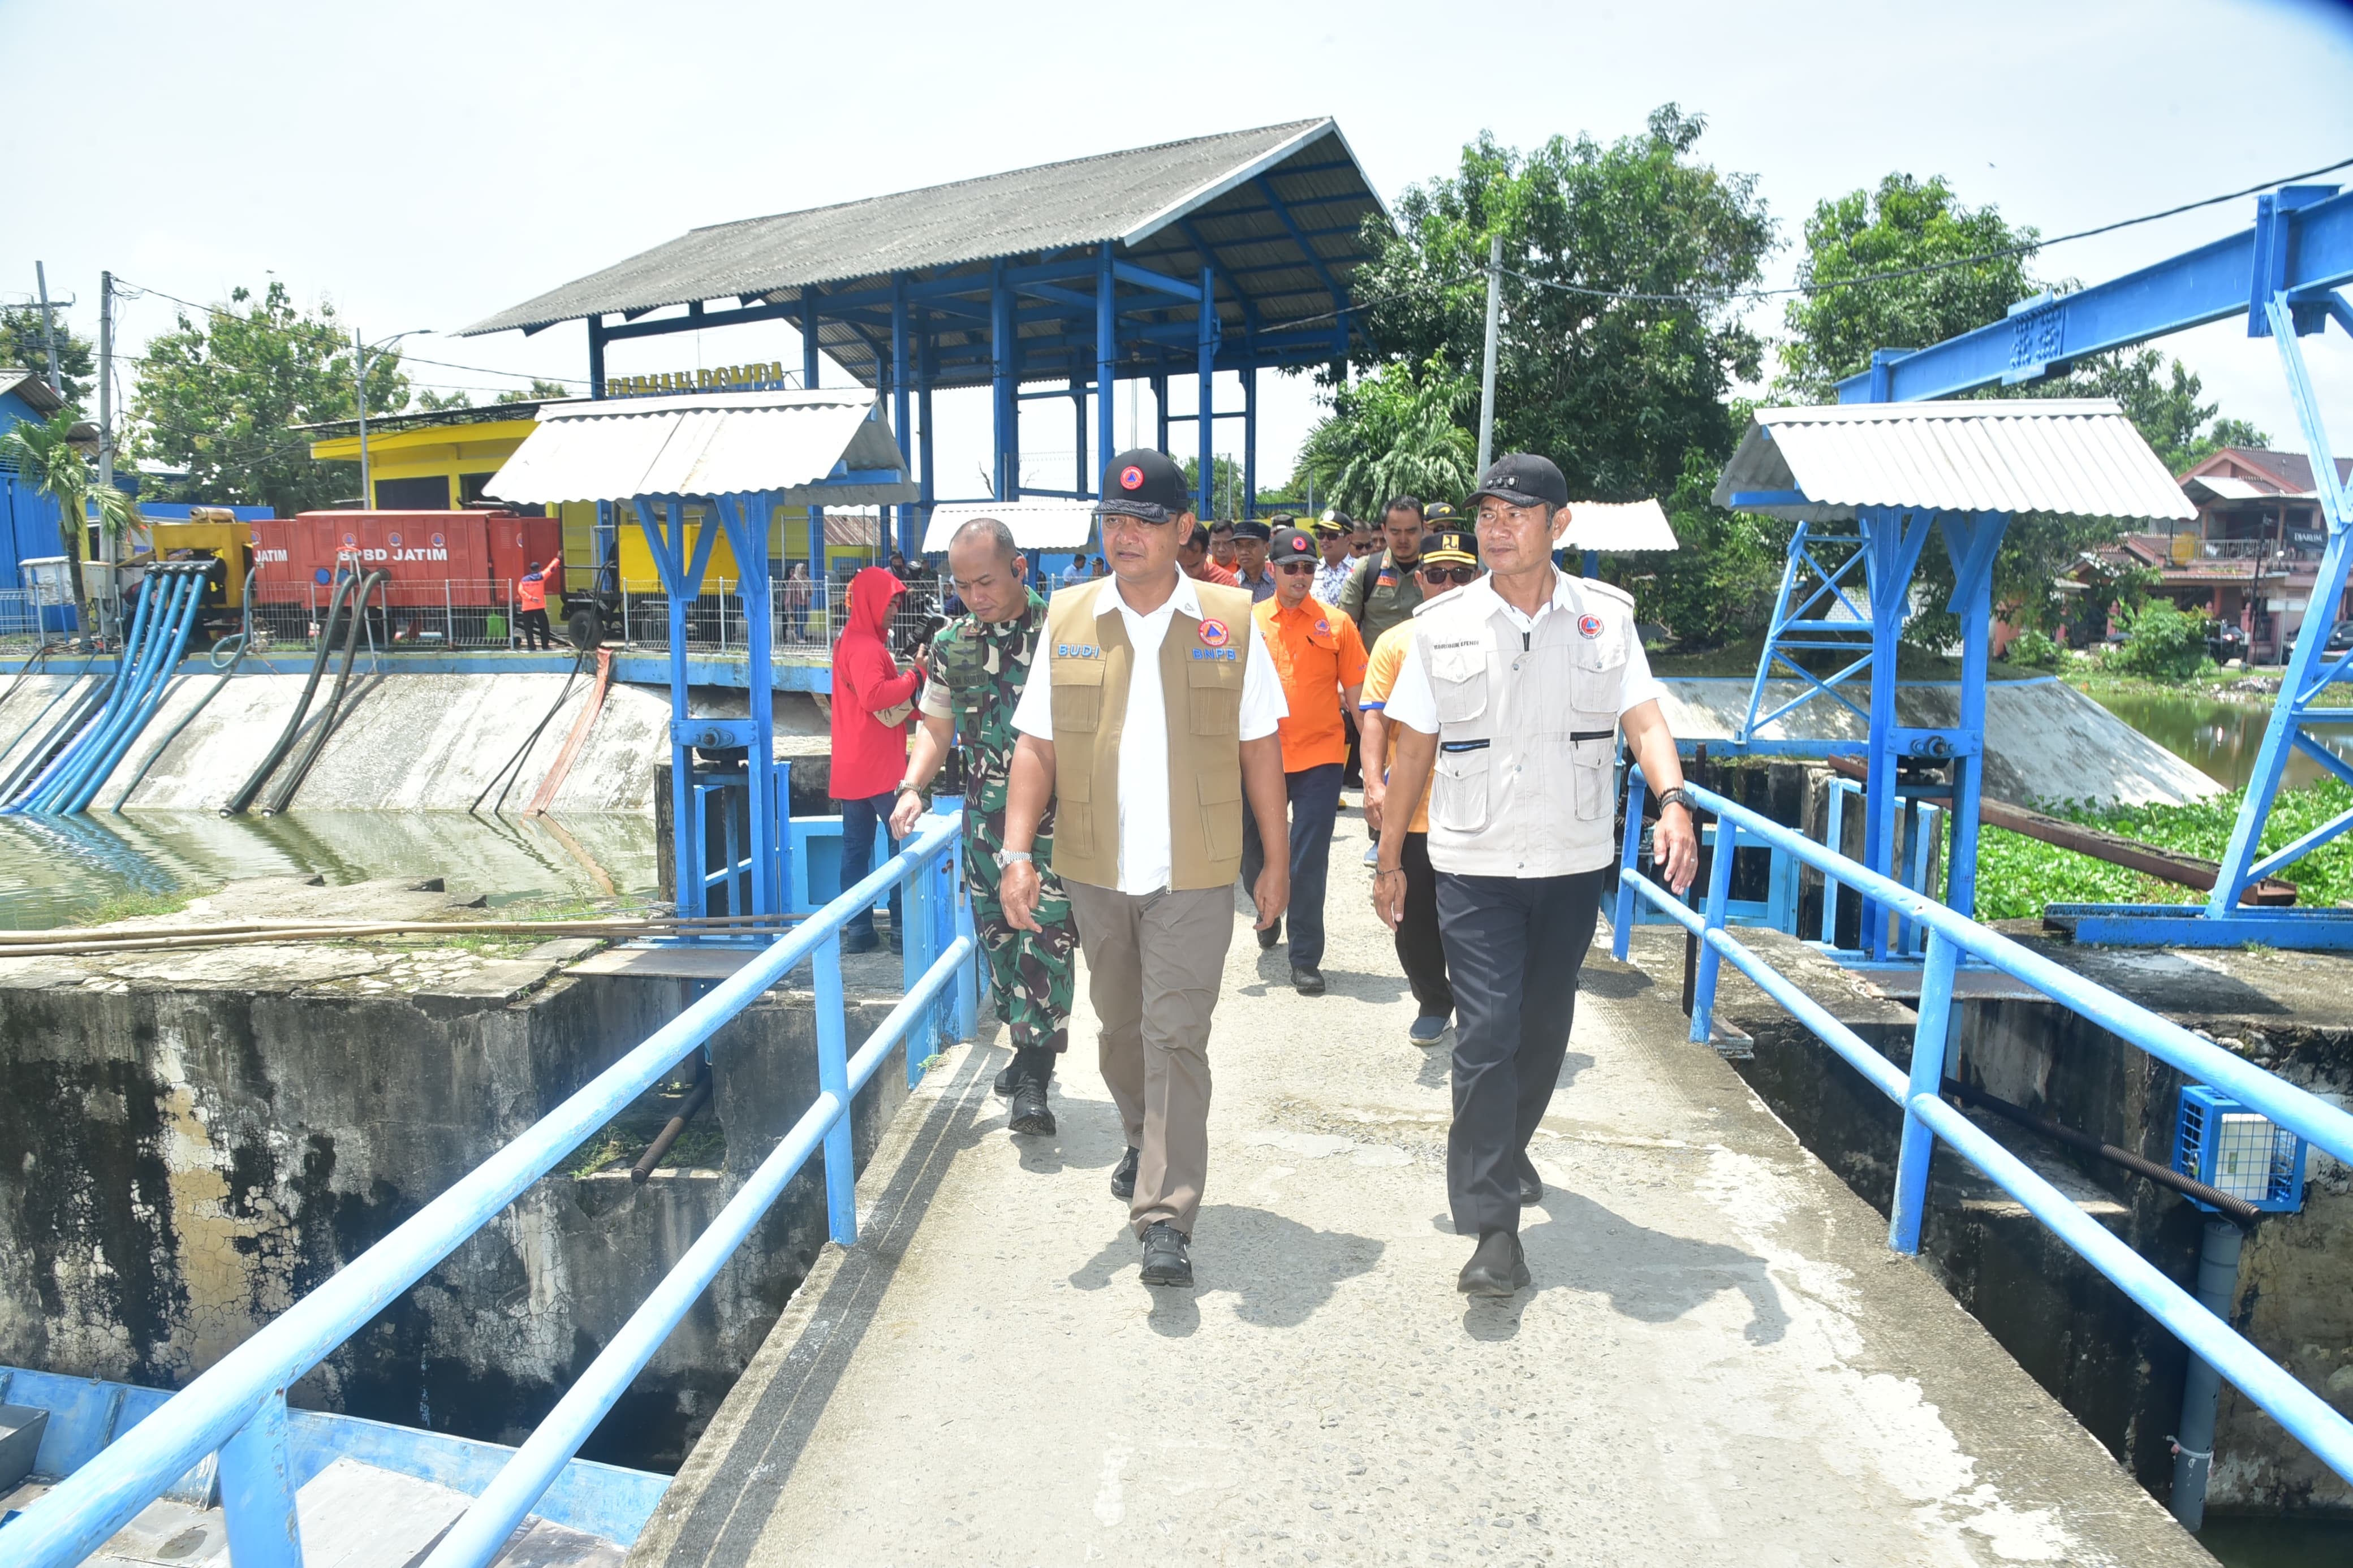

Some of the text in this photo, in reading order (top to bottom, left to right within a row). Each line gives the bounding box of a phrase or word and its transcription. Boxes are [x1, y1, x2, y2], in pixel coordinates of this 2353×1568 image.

[255, 549, 288, 562] JATIM
[392, 548, 448, 561] JATIM
[1058, 643, 1100, 658] BUDI
[1192, 648, 1236, 660] BNPB
